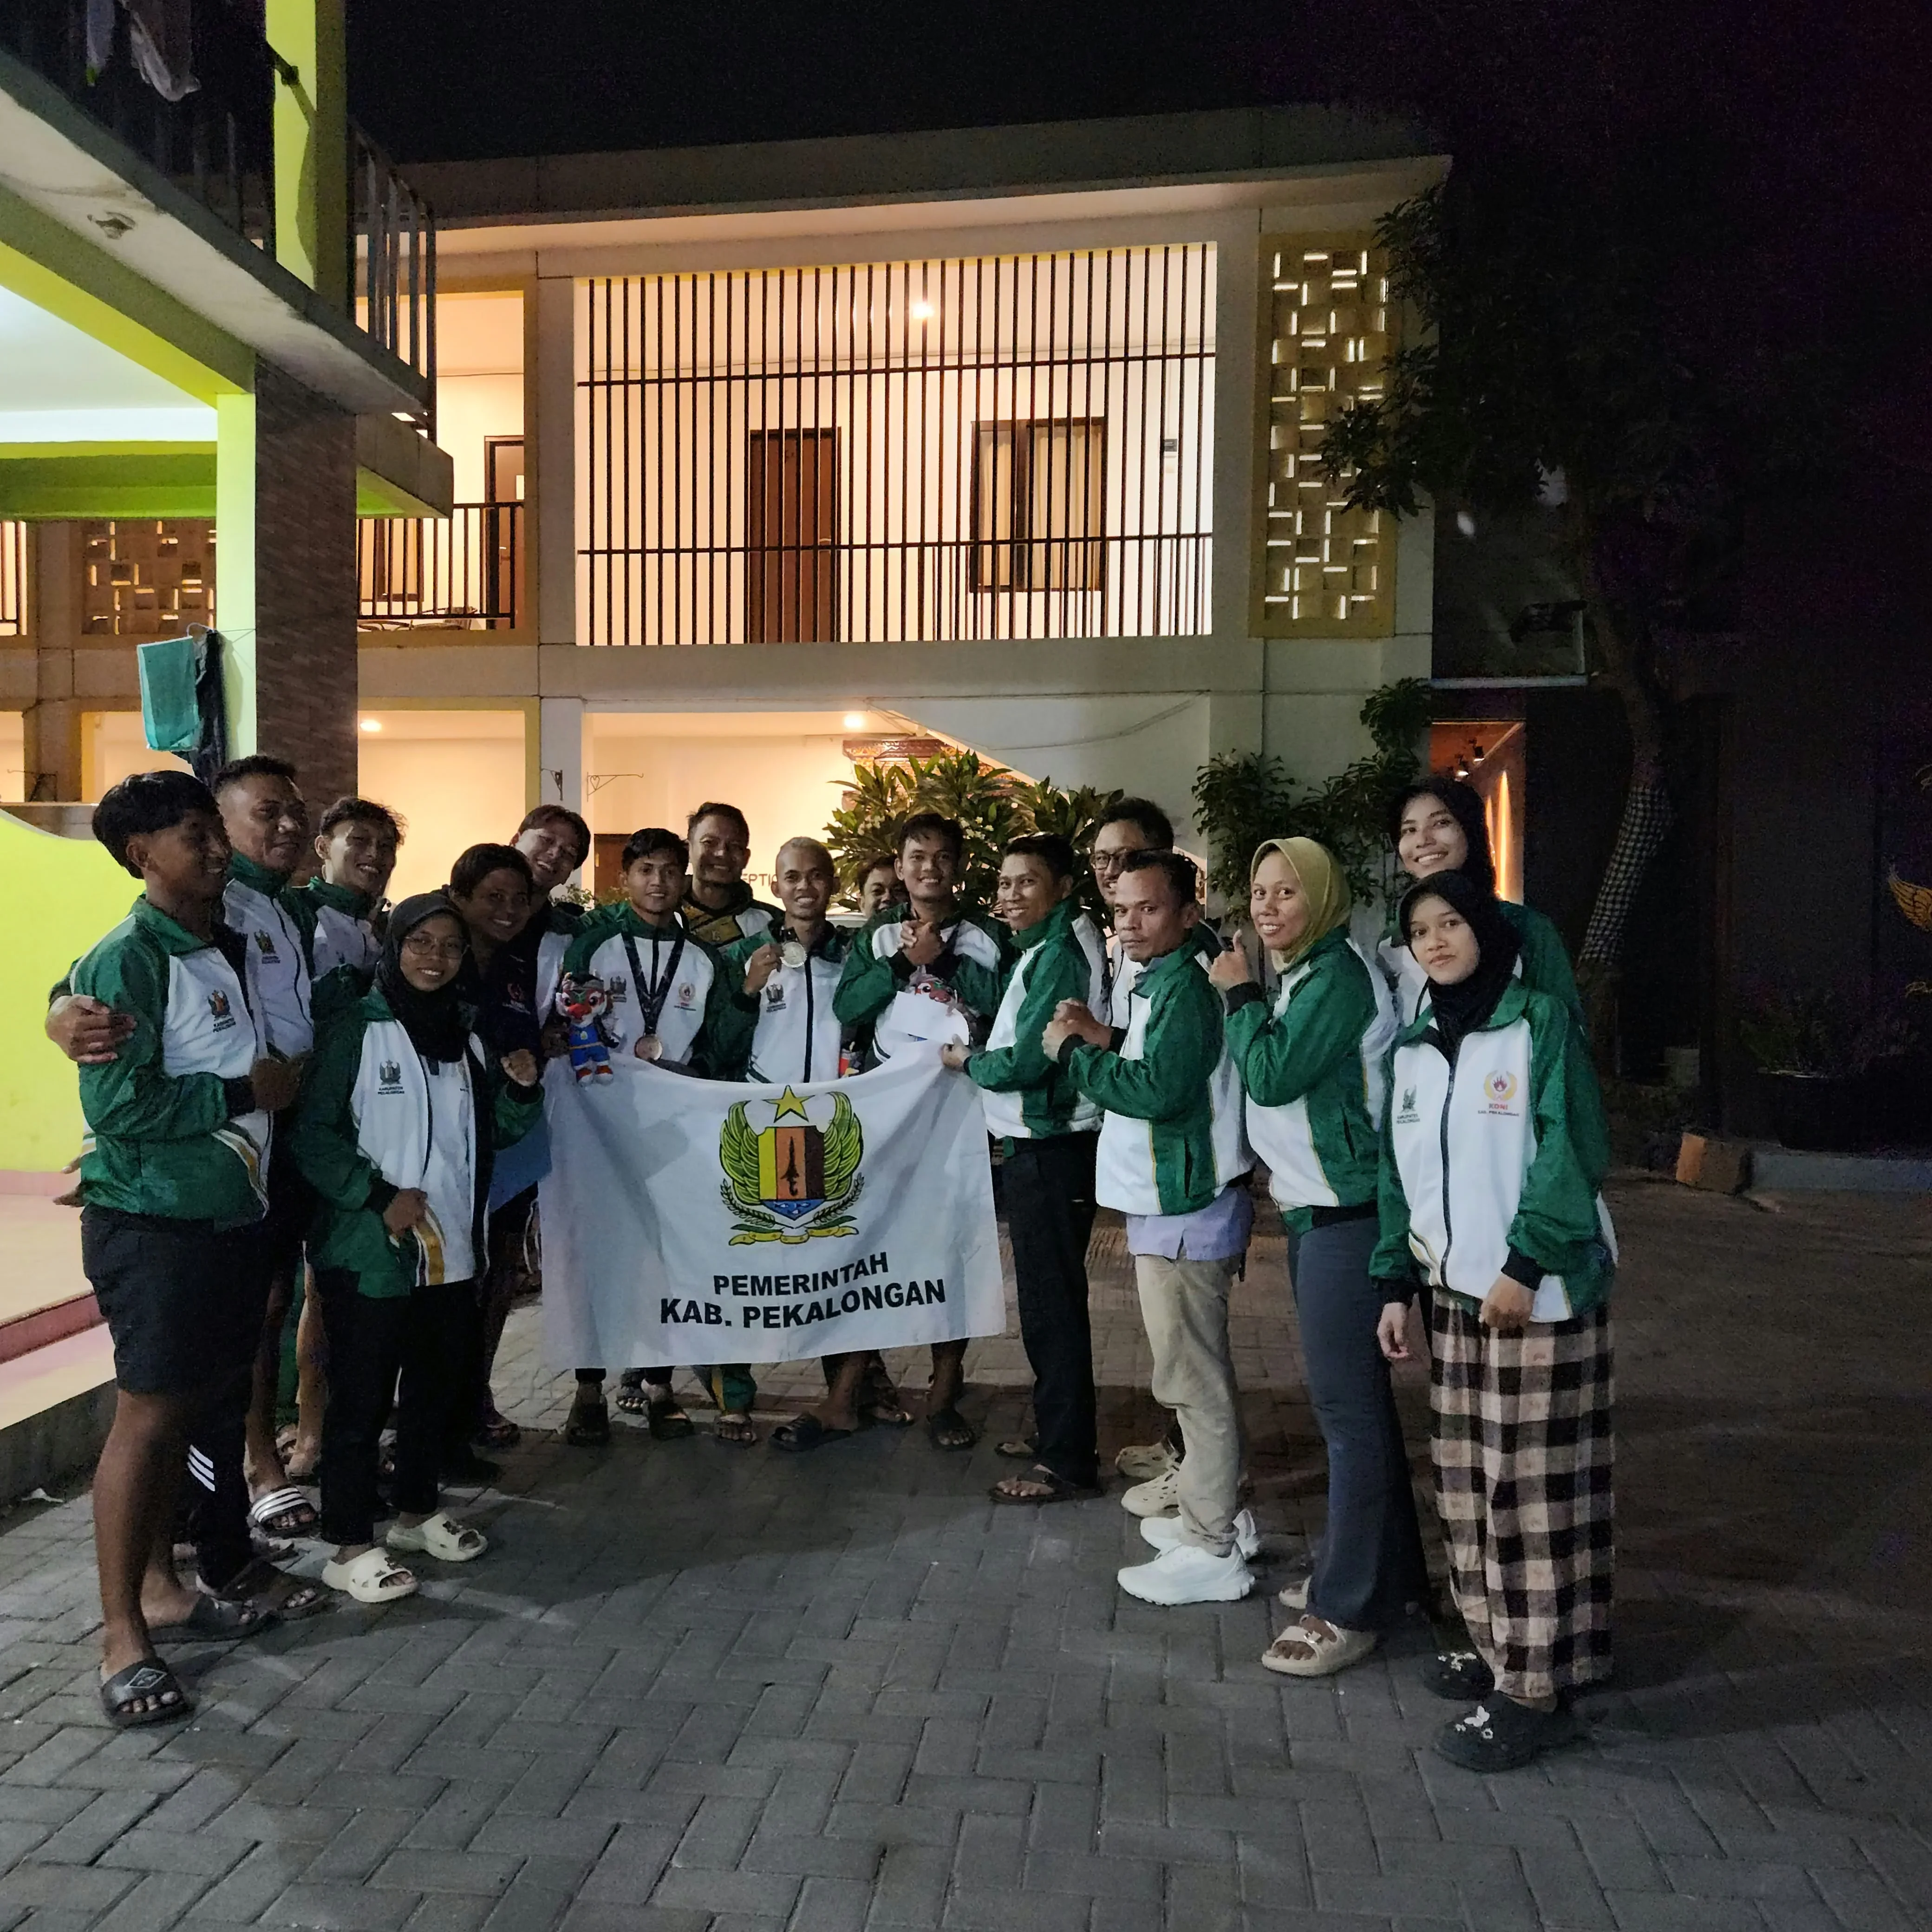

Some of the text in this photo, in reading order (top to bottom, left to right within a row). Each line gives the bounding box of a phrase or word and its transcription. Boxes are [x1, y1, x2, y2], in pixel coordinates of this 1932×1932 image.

[713, 1252, 888, 1296] PEMERINTAH
[660, 1279, 946, 1328] KAB. PEKALONGAN
